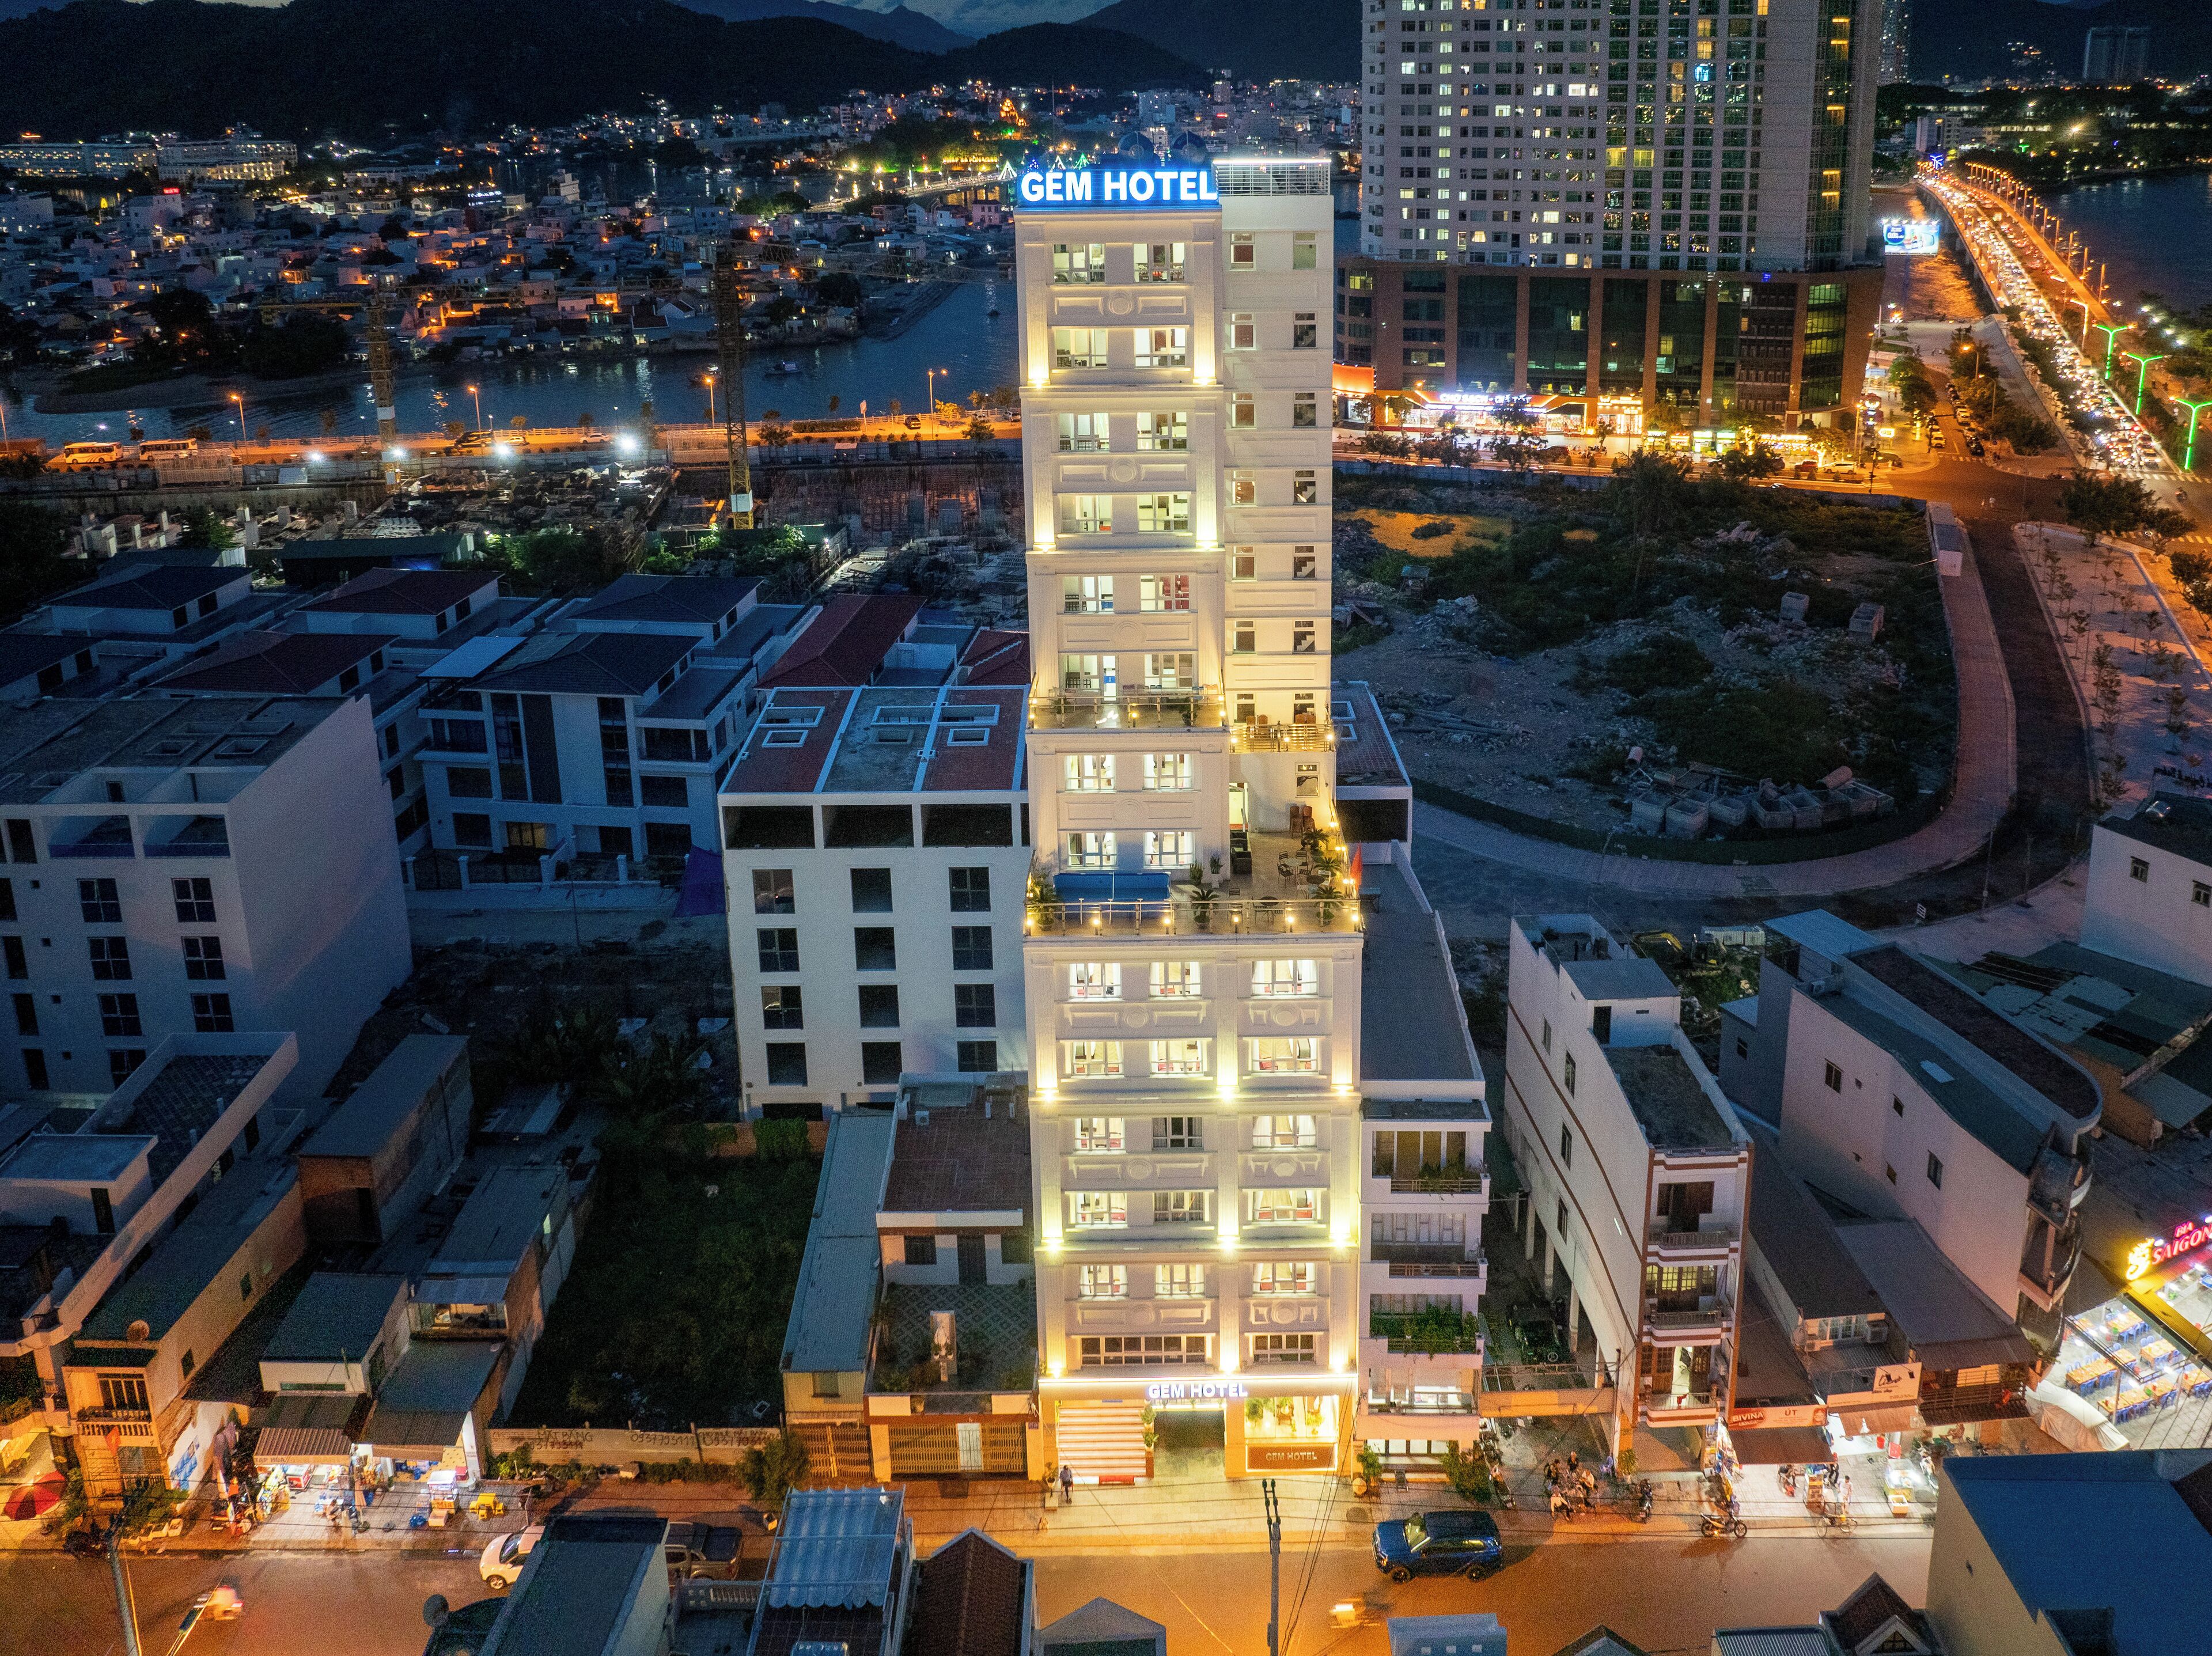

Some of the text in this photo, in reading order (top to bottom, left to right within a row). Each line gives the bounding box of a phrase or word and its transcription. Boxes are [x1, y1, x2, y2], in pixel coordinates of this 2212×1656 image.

[1020, 171, 1218, 202] GEM HOTEL
[2175, 1221, 2194, 1238] BIA
[1147, 1383, 1248, 1399] GEM HOTEL
[1732, 1412, 1764, 1423] BIVINA
[1266, 1452, 1318, 1461] GEM HOTEL
